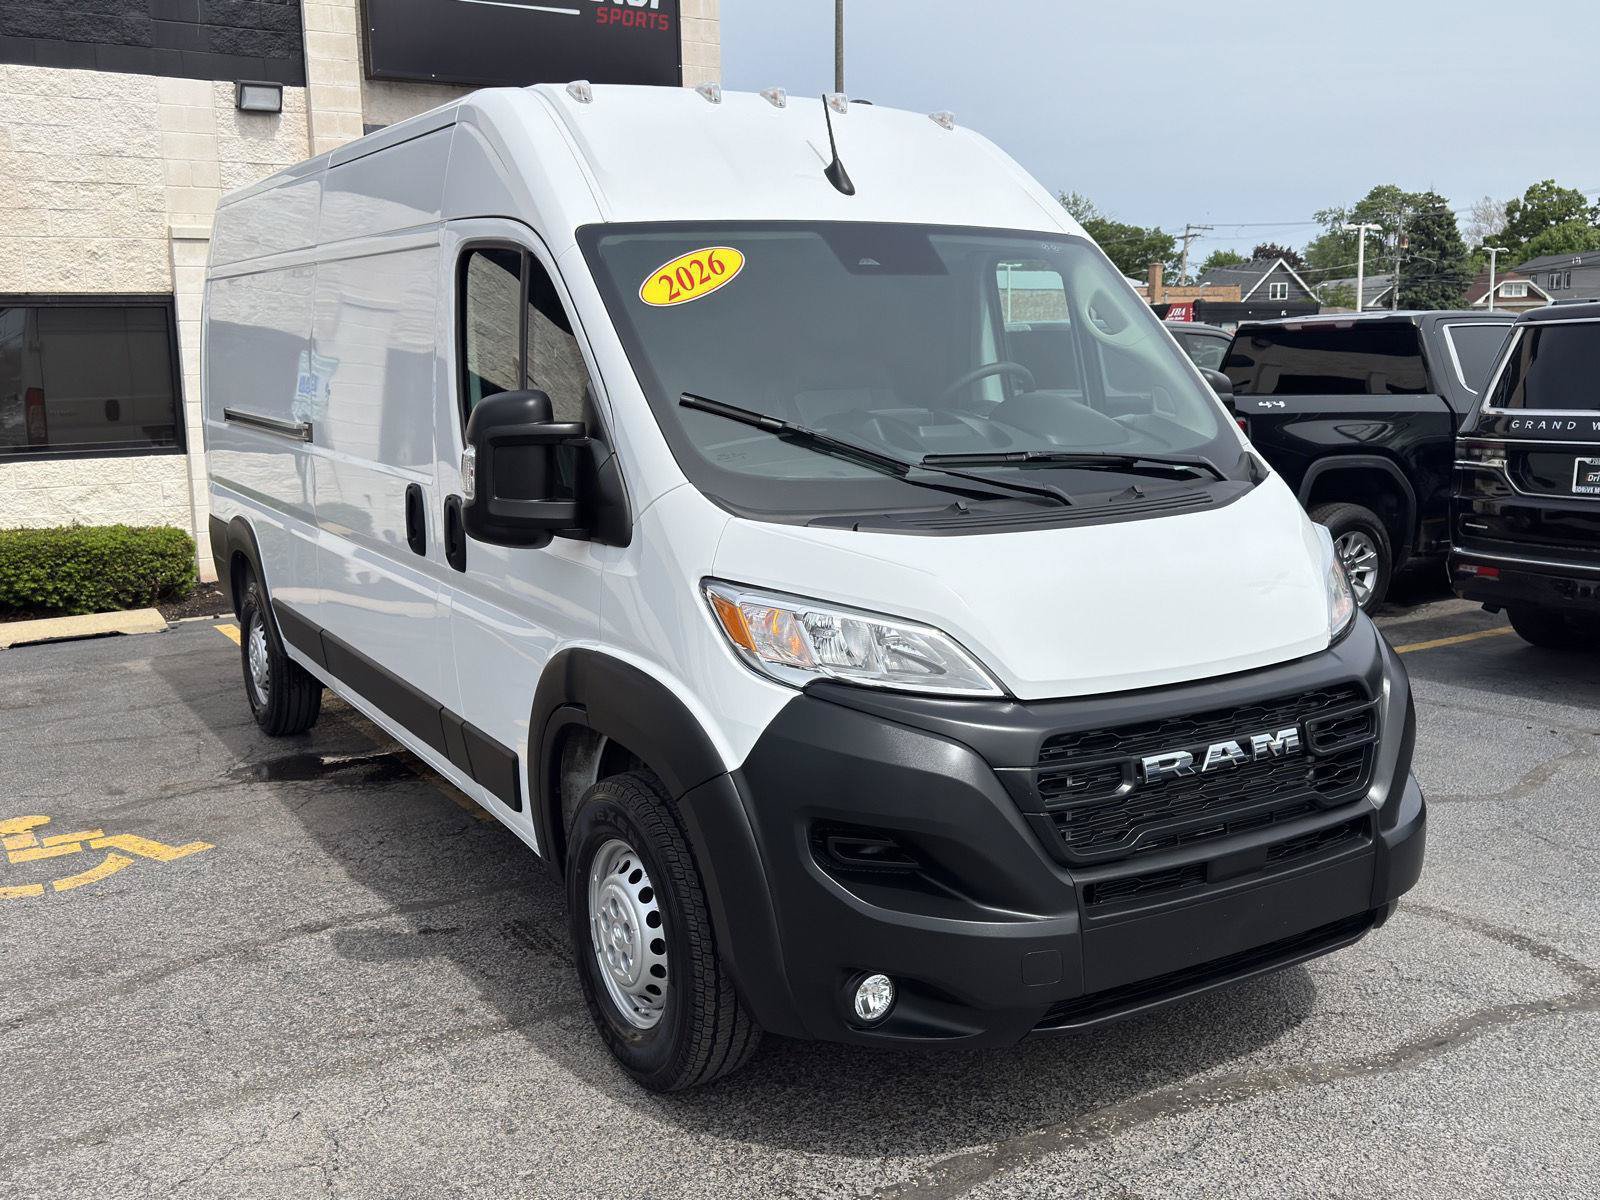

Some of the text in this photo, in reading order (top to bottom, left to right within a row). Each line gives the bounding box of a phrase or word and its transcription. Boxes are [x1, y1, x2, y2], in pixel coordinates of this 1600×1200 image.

[595, 7, 670, 31] SPORTS
[658, 250, 726, 301] 2026
[1511, 420, 1577, 431] GRAND
[1141, 727, 1300, 784] RAM
